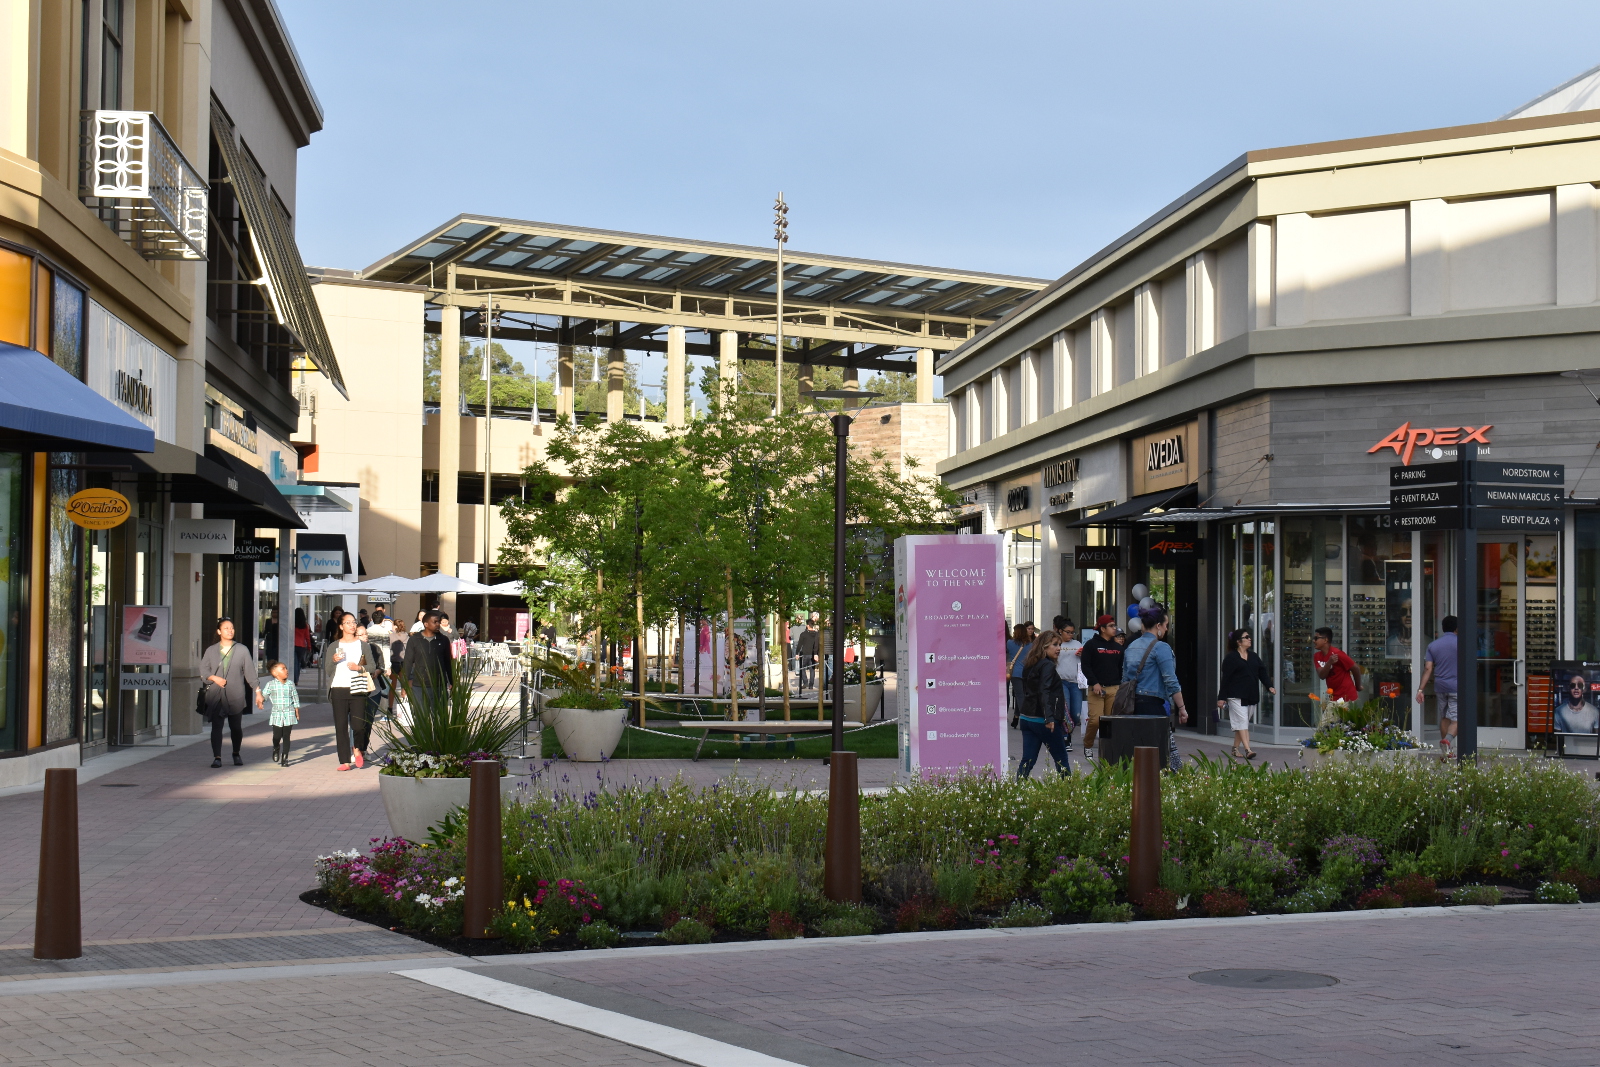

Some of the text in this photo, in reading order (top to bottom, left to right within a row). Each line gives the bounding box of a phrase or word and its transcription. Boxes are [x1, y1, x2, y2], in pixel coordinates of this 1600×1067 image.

[1366, 421, 1494, 466] APEX
[1147, 435, 1182, 471] AVEDA
[1044, 458, 1078, 488] MINISTRY
[1401, 470, 1426, 480] PARKING
[1502, 468, 1550, 478] NORDSTROM
[1401, 492, 1440, 503] EVENT PLAZA
[1487, 491, 1551, 501] NEIMAN MARCUS
[1401, 516, 1437, 526] RESTROOMS
[1501, 515, 1551, 525] EVENT PLAZA
[234, 545, 270, 554] ALKING
[1079, 552, 1117, 561] AVEDA
[313, 558, 341, 567] ivivva
[925, 568, 987, 578] WELCOME
